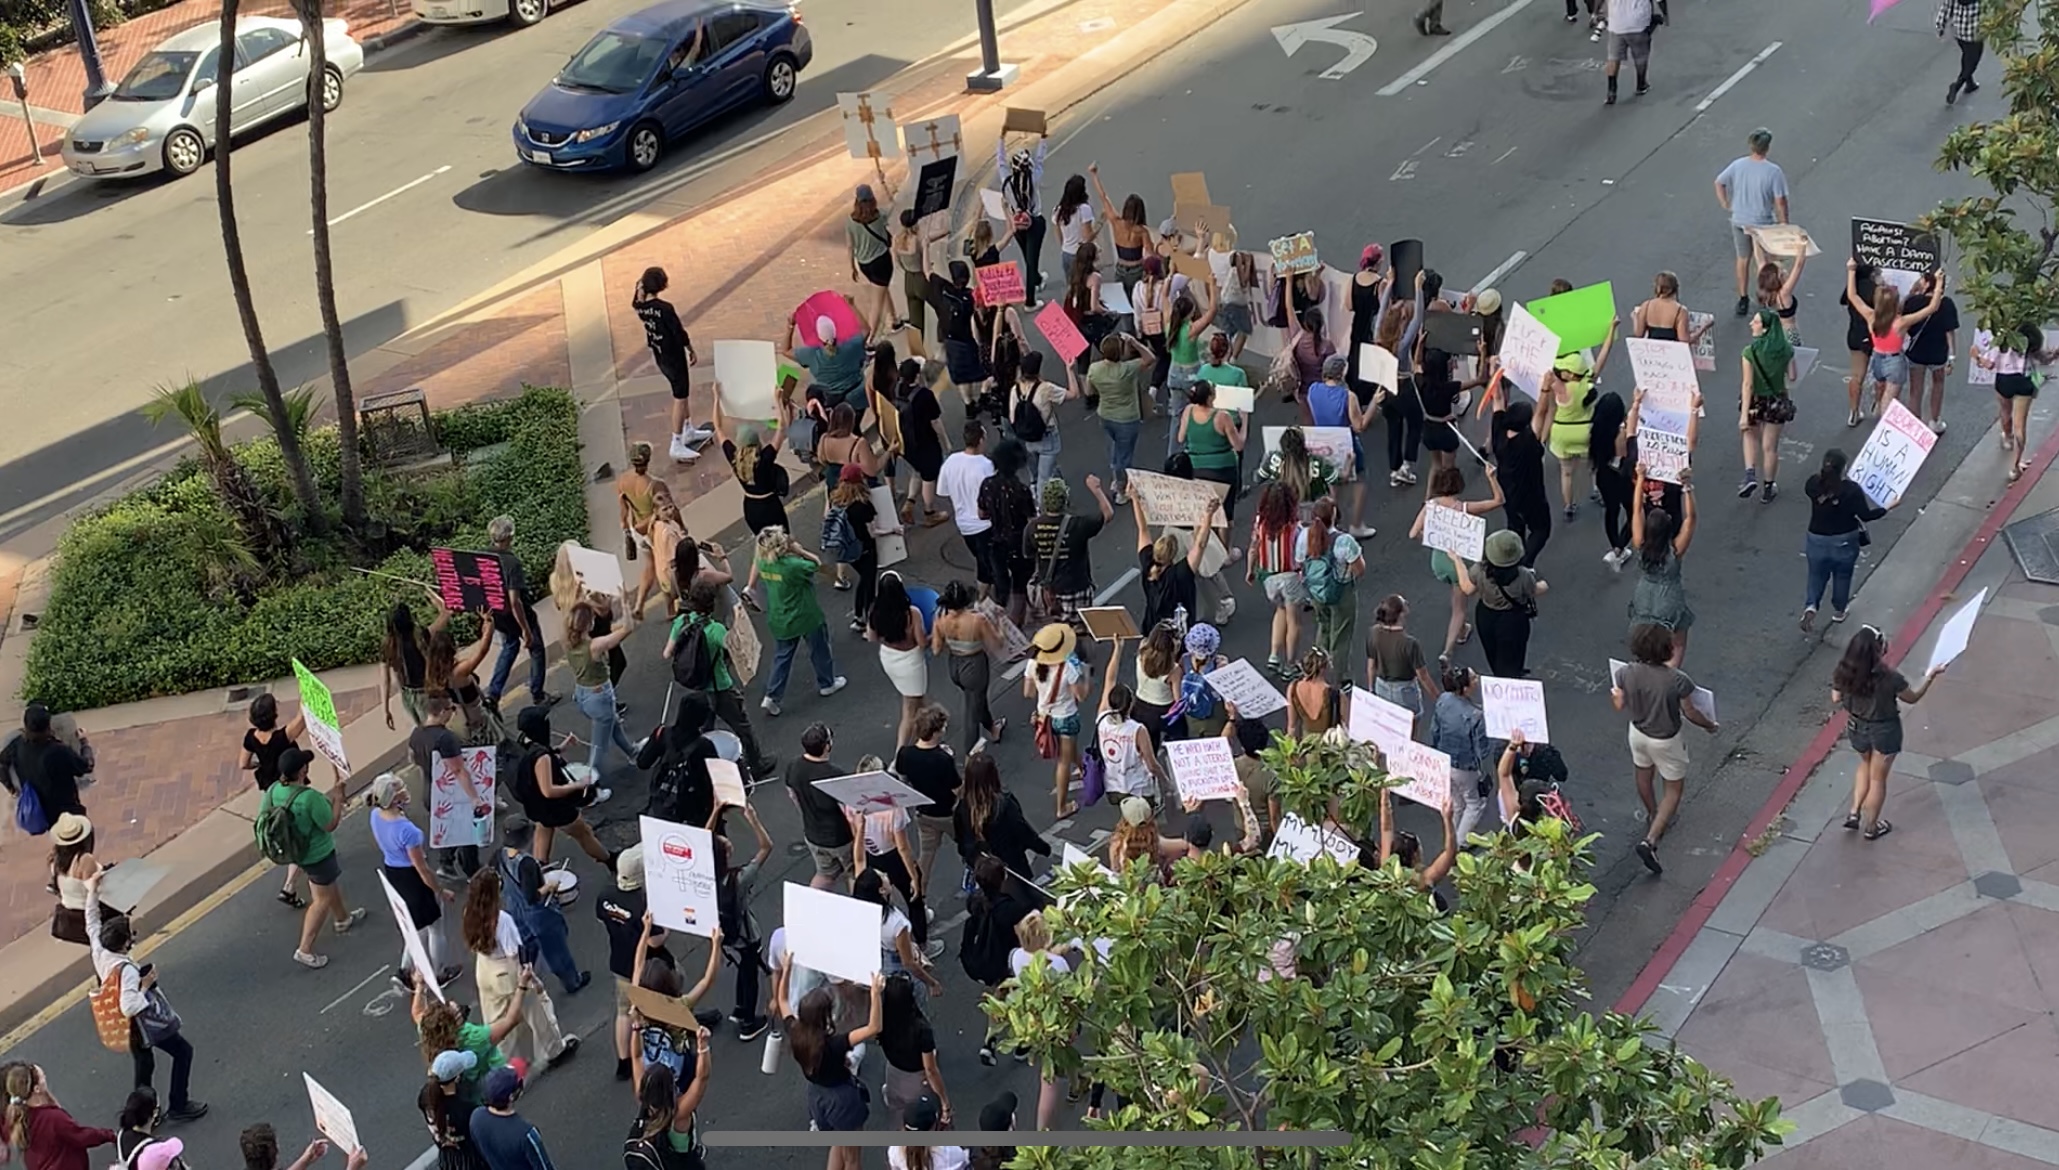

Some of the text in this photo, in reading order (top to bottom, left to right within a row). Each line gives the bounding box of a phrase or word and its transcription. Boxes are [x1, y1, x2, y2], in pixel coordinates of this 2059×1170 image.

[1299, 236, 1312, 252] A
[1885, 246, 1896, 257] A
[1876, 427, 1893, 448] IS
[1861, 441, 1911, 486] HUMAN
[1894, 443, 1909, 464] A
[1851, 465, 1899, 504] RIGHT
[1428, 503, 1486, 535] REEDOM
[431, 548, 466, 611] HEALTHCARE
[462, 575, 481, 586] IS
[474, 557, 505, 610] ABORTION
